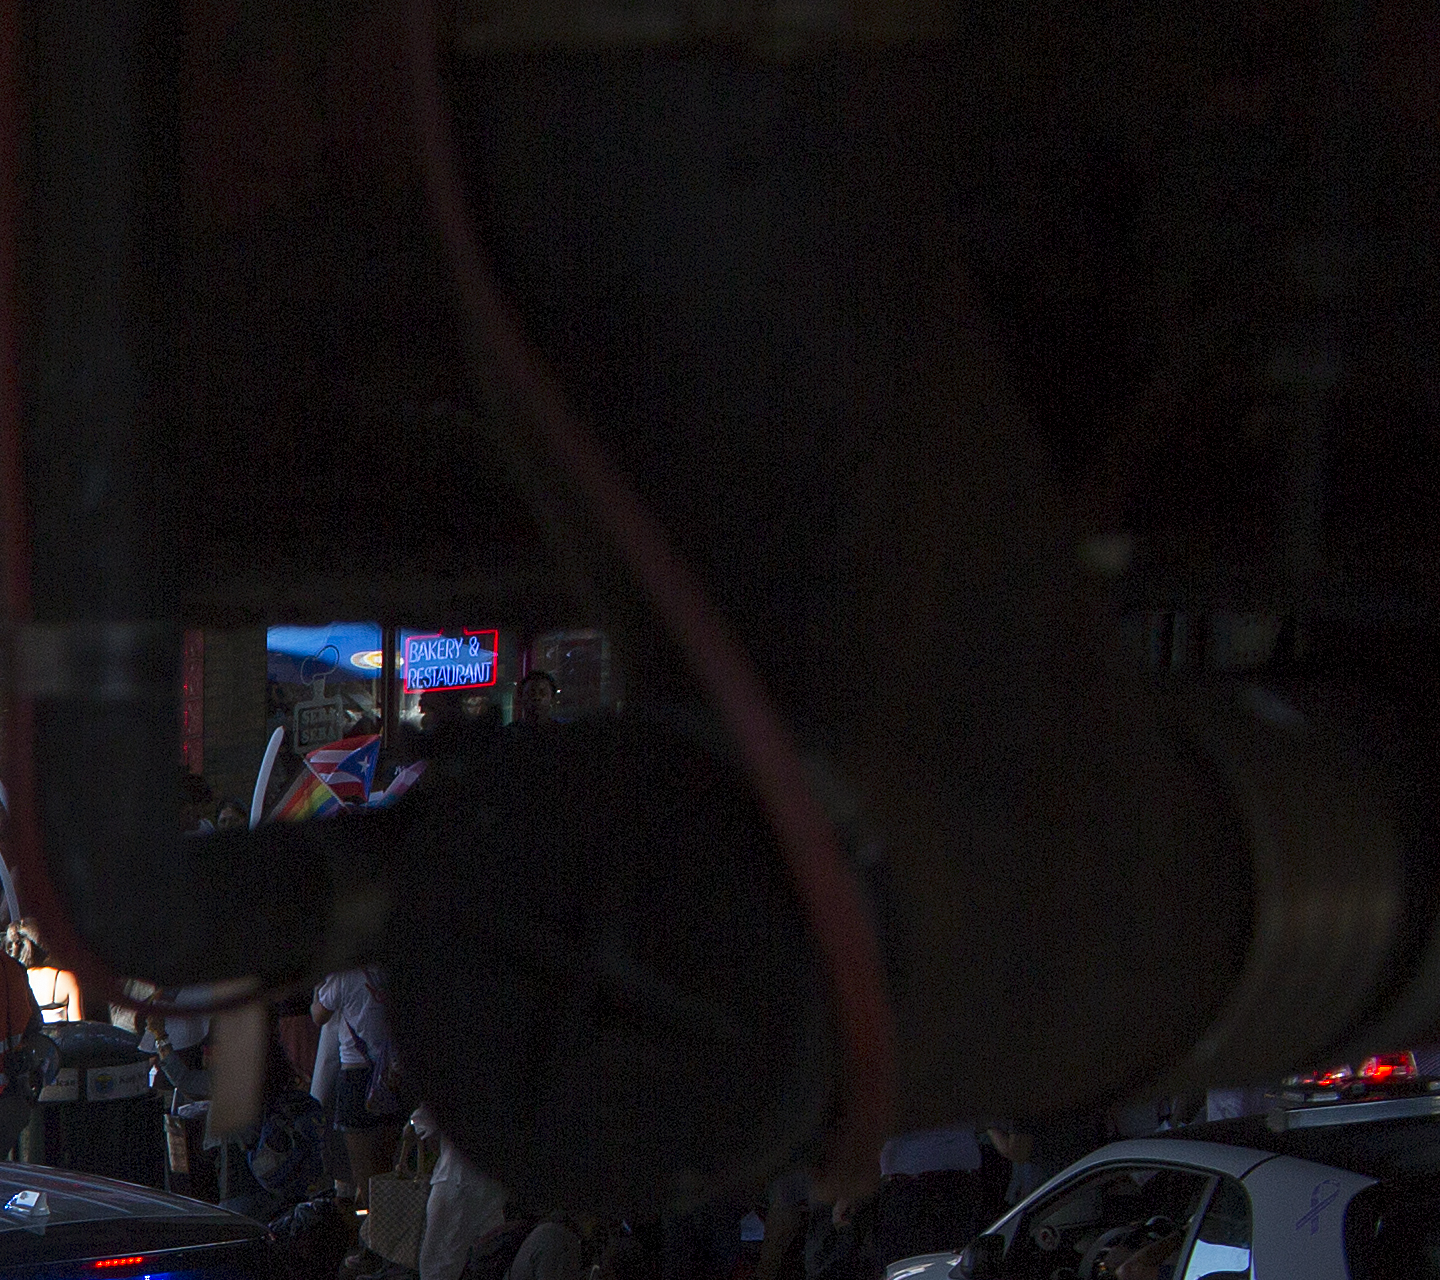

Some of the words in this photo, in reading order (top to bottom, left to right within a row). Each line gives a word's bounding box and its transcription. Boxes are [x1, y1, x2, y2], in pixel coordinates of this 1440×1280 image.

[408, 637, 464, 663] BAKERY
[468, 636, 481, 657] &
[407, 661, 493, 690] RESTAURANT
